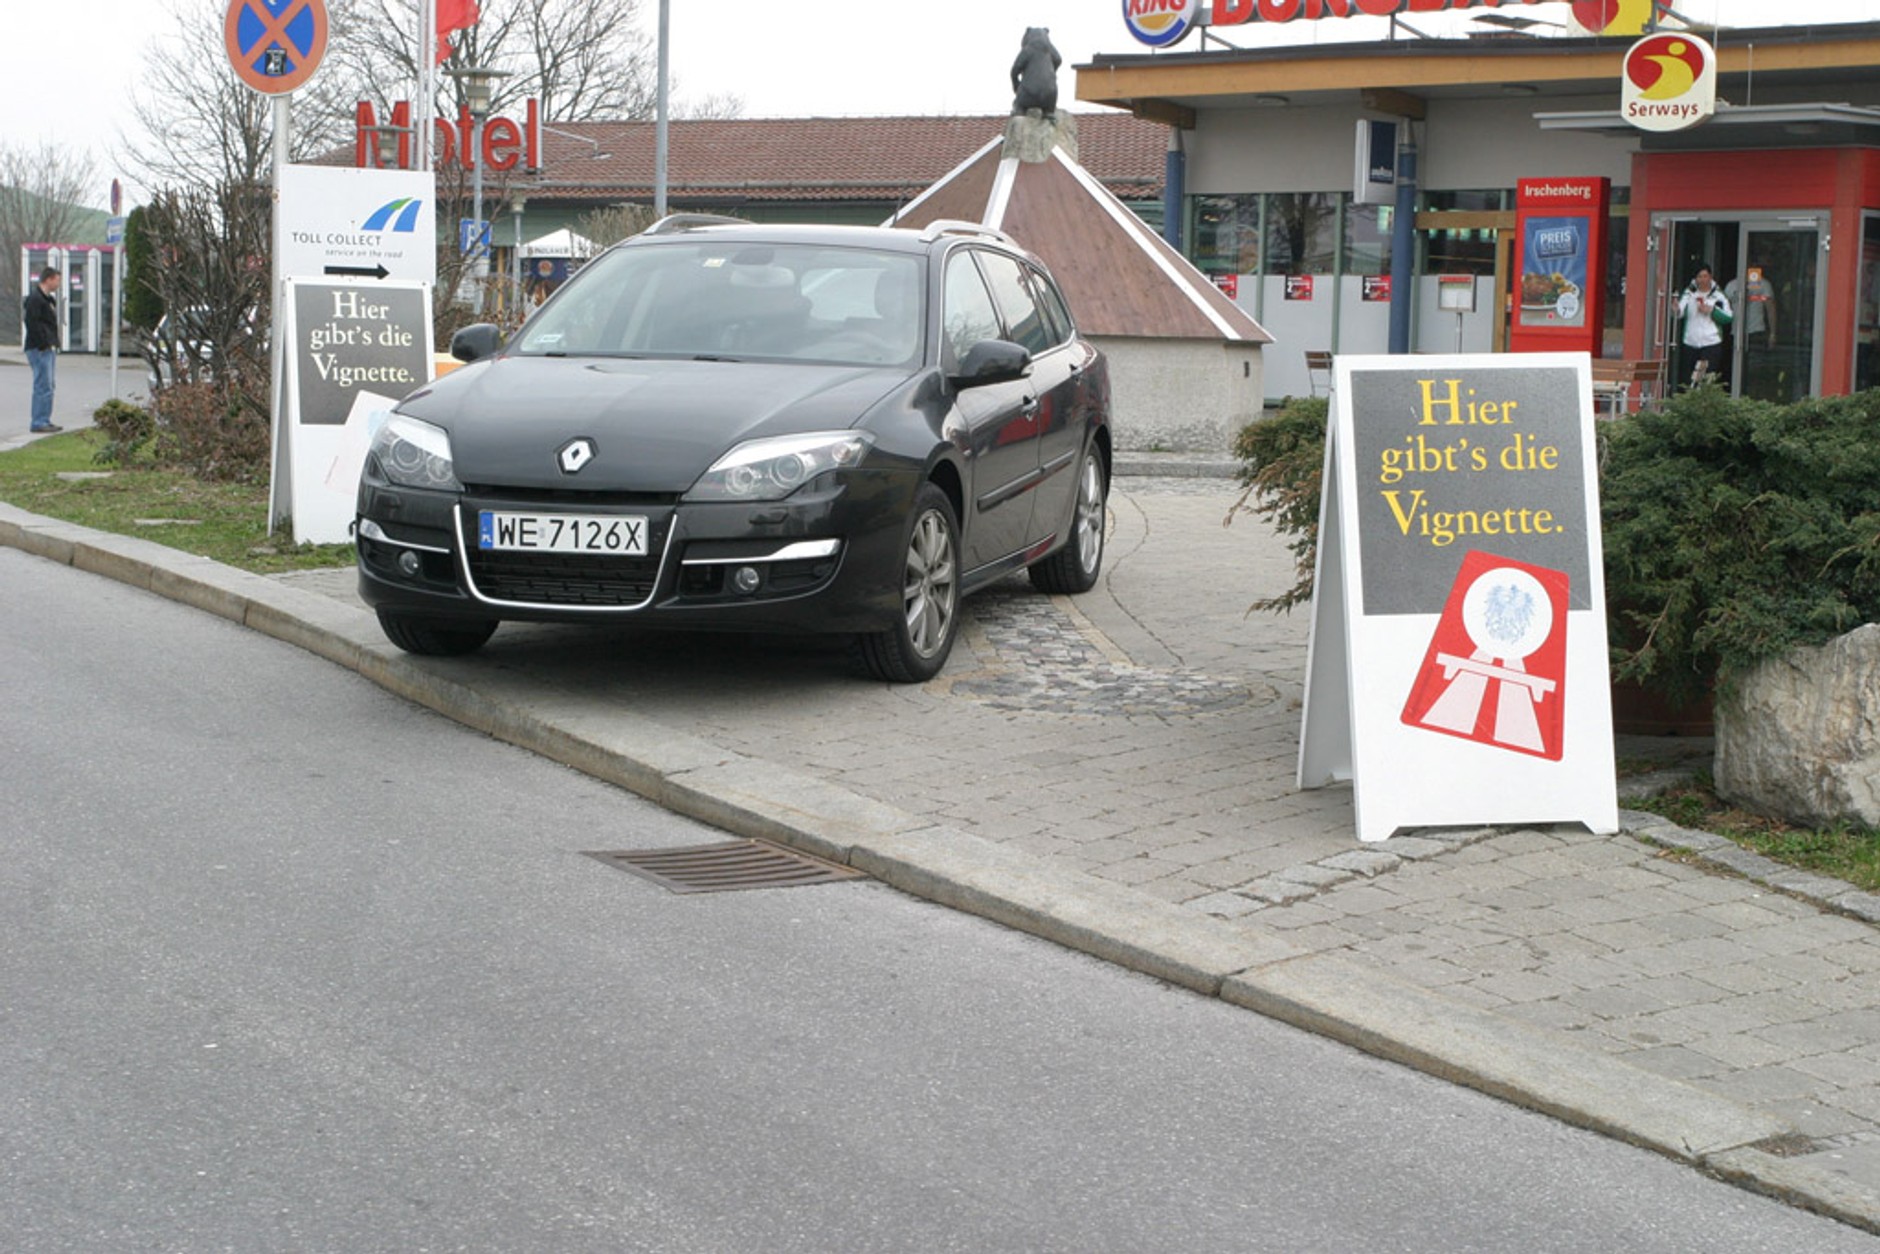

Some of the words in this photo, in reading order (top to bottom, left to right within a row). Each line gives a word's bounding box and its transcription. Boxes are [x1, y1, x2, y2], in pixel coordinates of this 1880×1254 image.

[1628, 101, 1699, 118] Serways
[1525, 184, 1592, 199] Irschenberg
[292, 232, 322, 244] TOLL
[327, 233, 382, 246] COLLECT
[1540, 230, 1571, 244] PREIS
[332, 290, 390, 319] Hier
[310, 322, 372, 350] gibt's
[378, 324, 413, 347] die
[310, 353, 415, 387] Vignette.
[1416, 378, 1518, 425] Hier
[1380, 433, 1489, 484] gibt's
[1500, 432, 1559, 470] die
[1380, 489, 1564, 547] Vignette.
[497, 517, 538, 547] WE
[549, 519, 642, 550] 7126X
